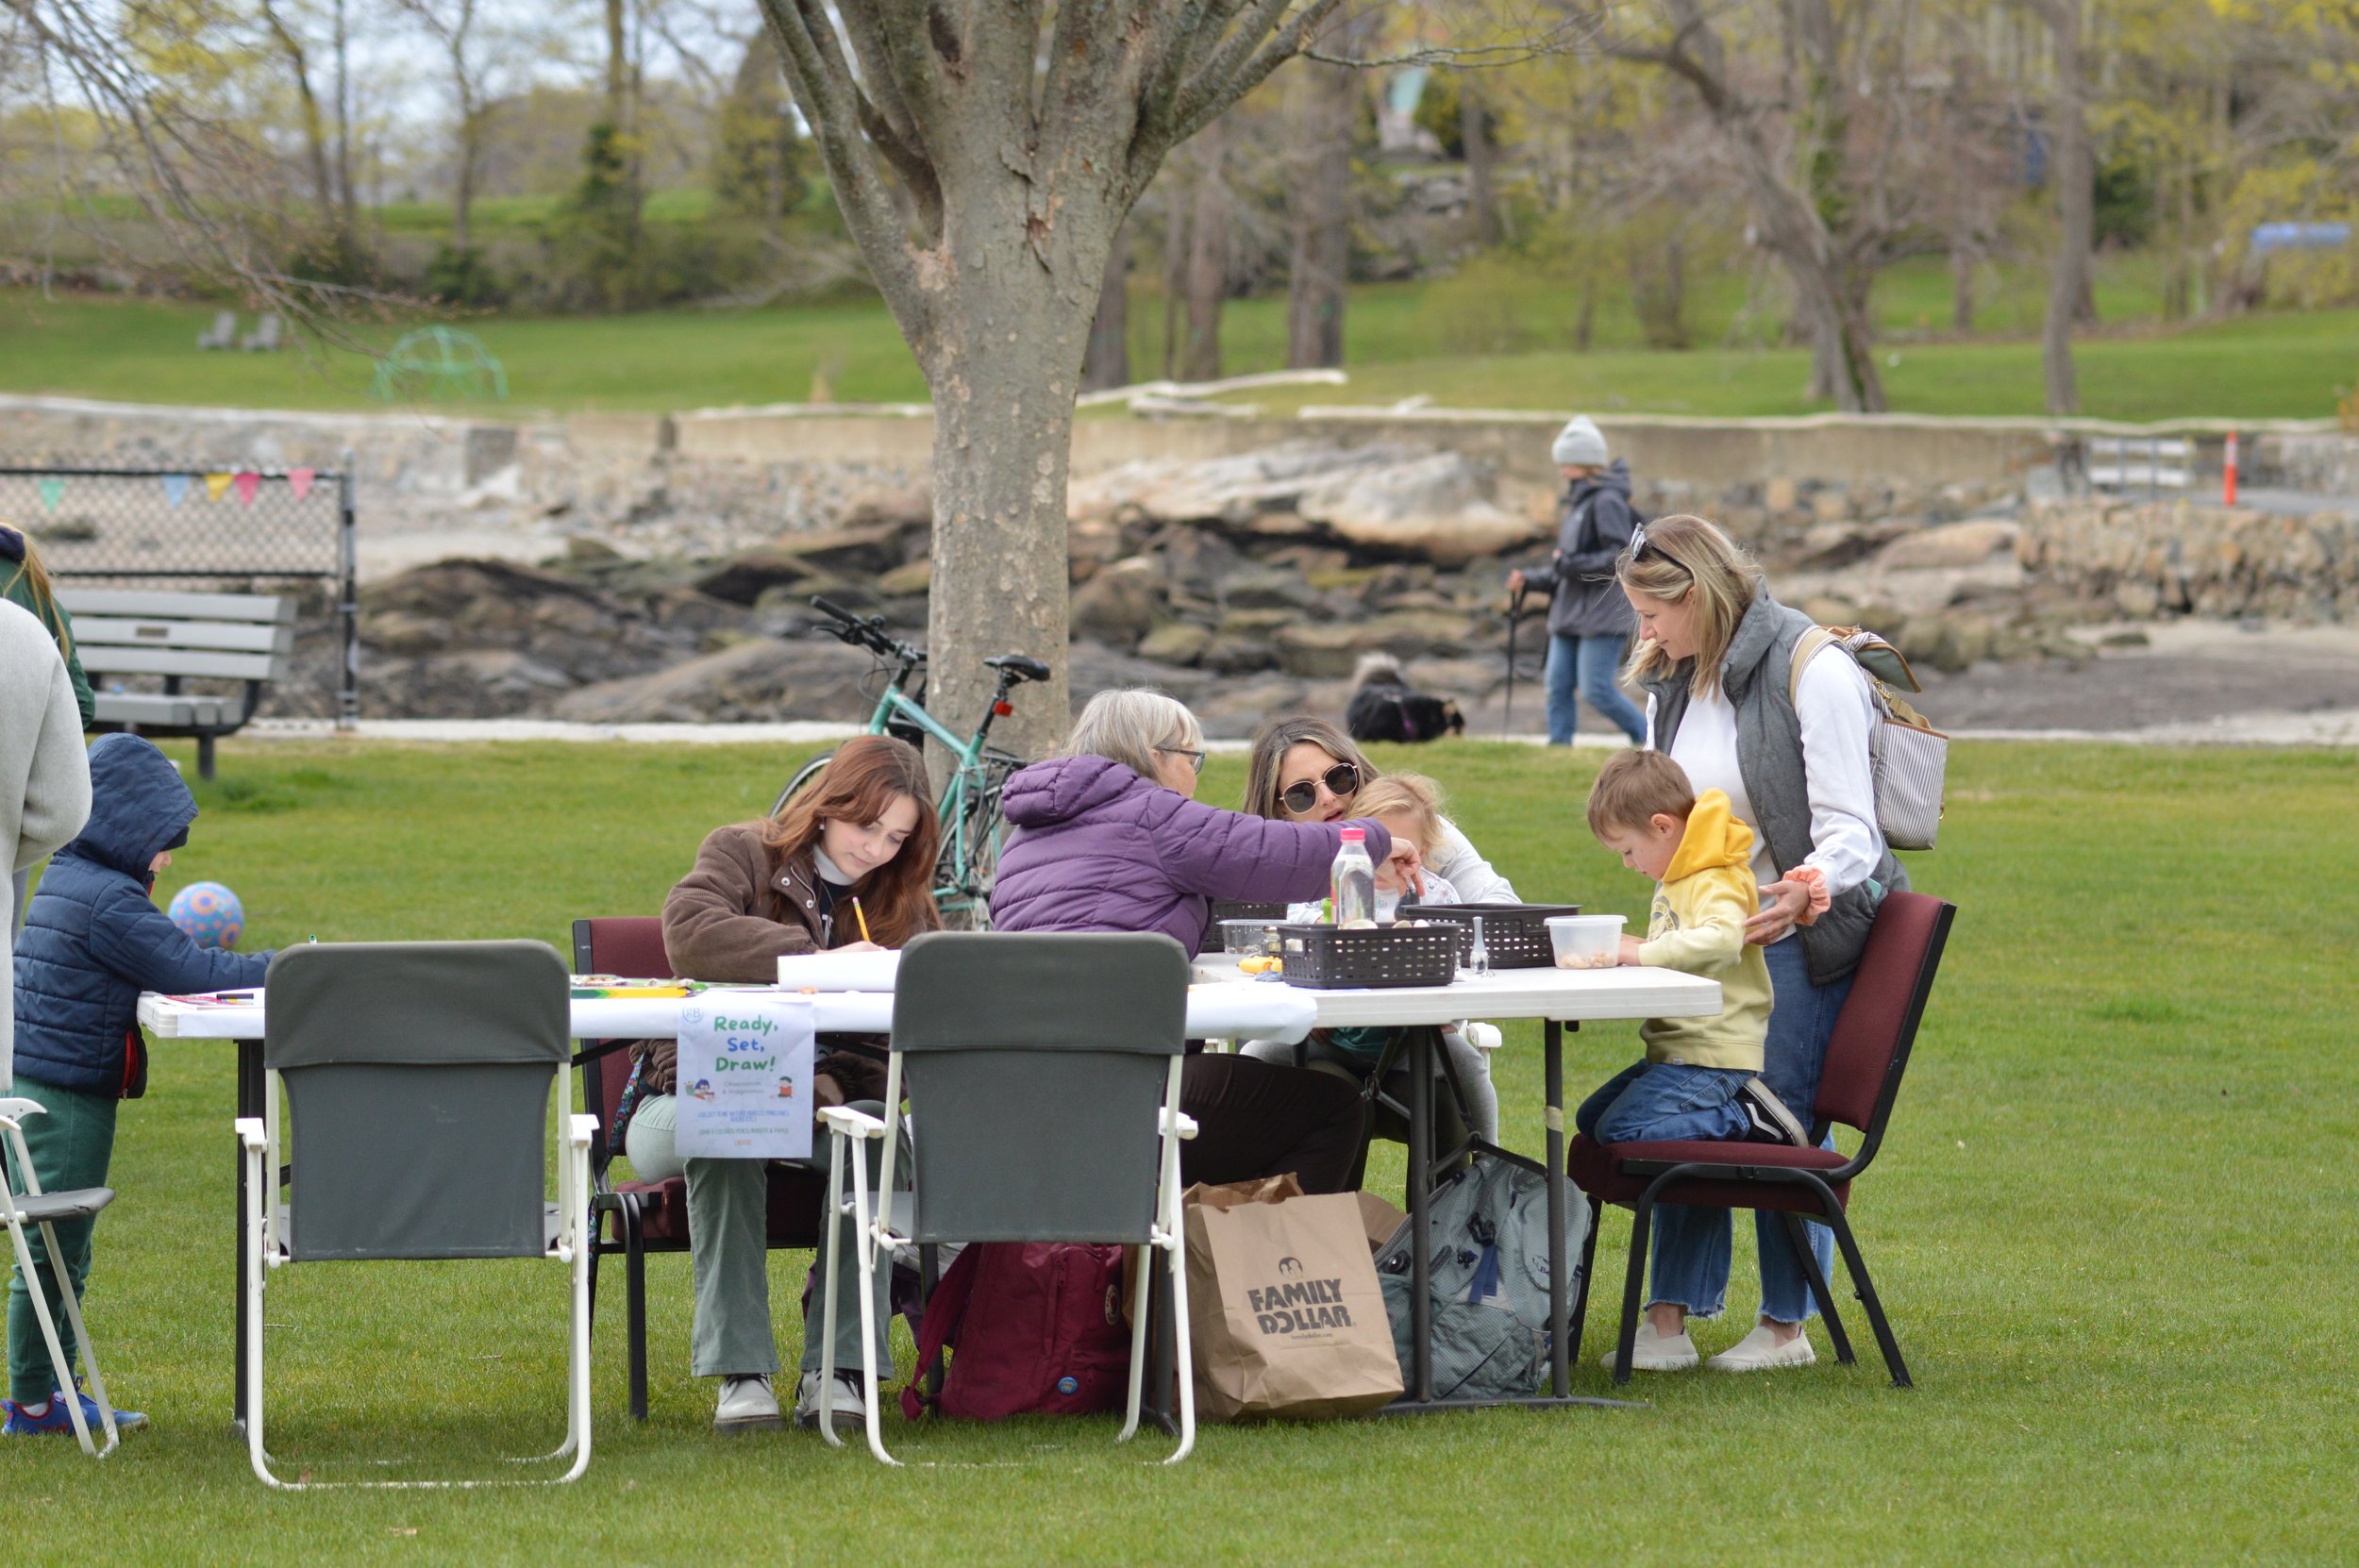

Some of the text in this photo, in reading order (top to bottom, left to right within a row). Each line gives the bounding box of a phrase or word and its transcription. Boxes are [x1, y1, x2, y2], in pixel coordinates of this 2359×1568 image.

[714, 1014, 778, 1036] Ready,
[727, 1037, 765, 1053] Set,
[715, 1056, 776, 1072] Draw!
[1246, 1278, 1343, 1312] FAMILY
[1257, 1305, 1352, 1335] DOLLAR
